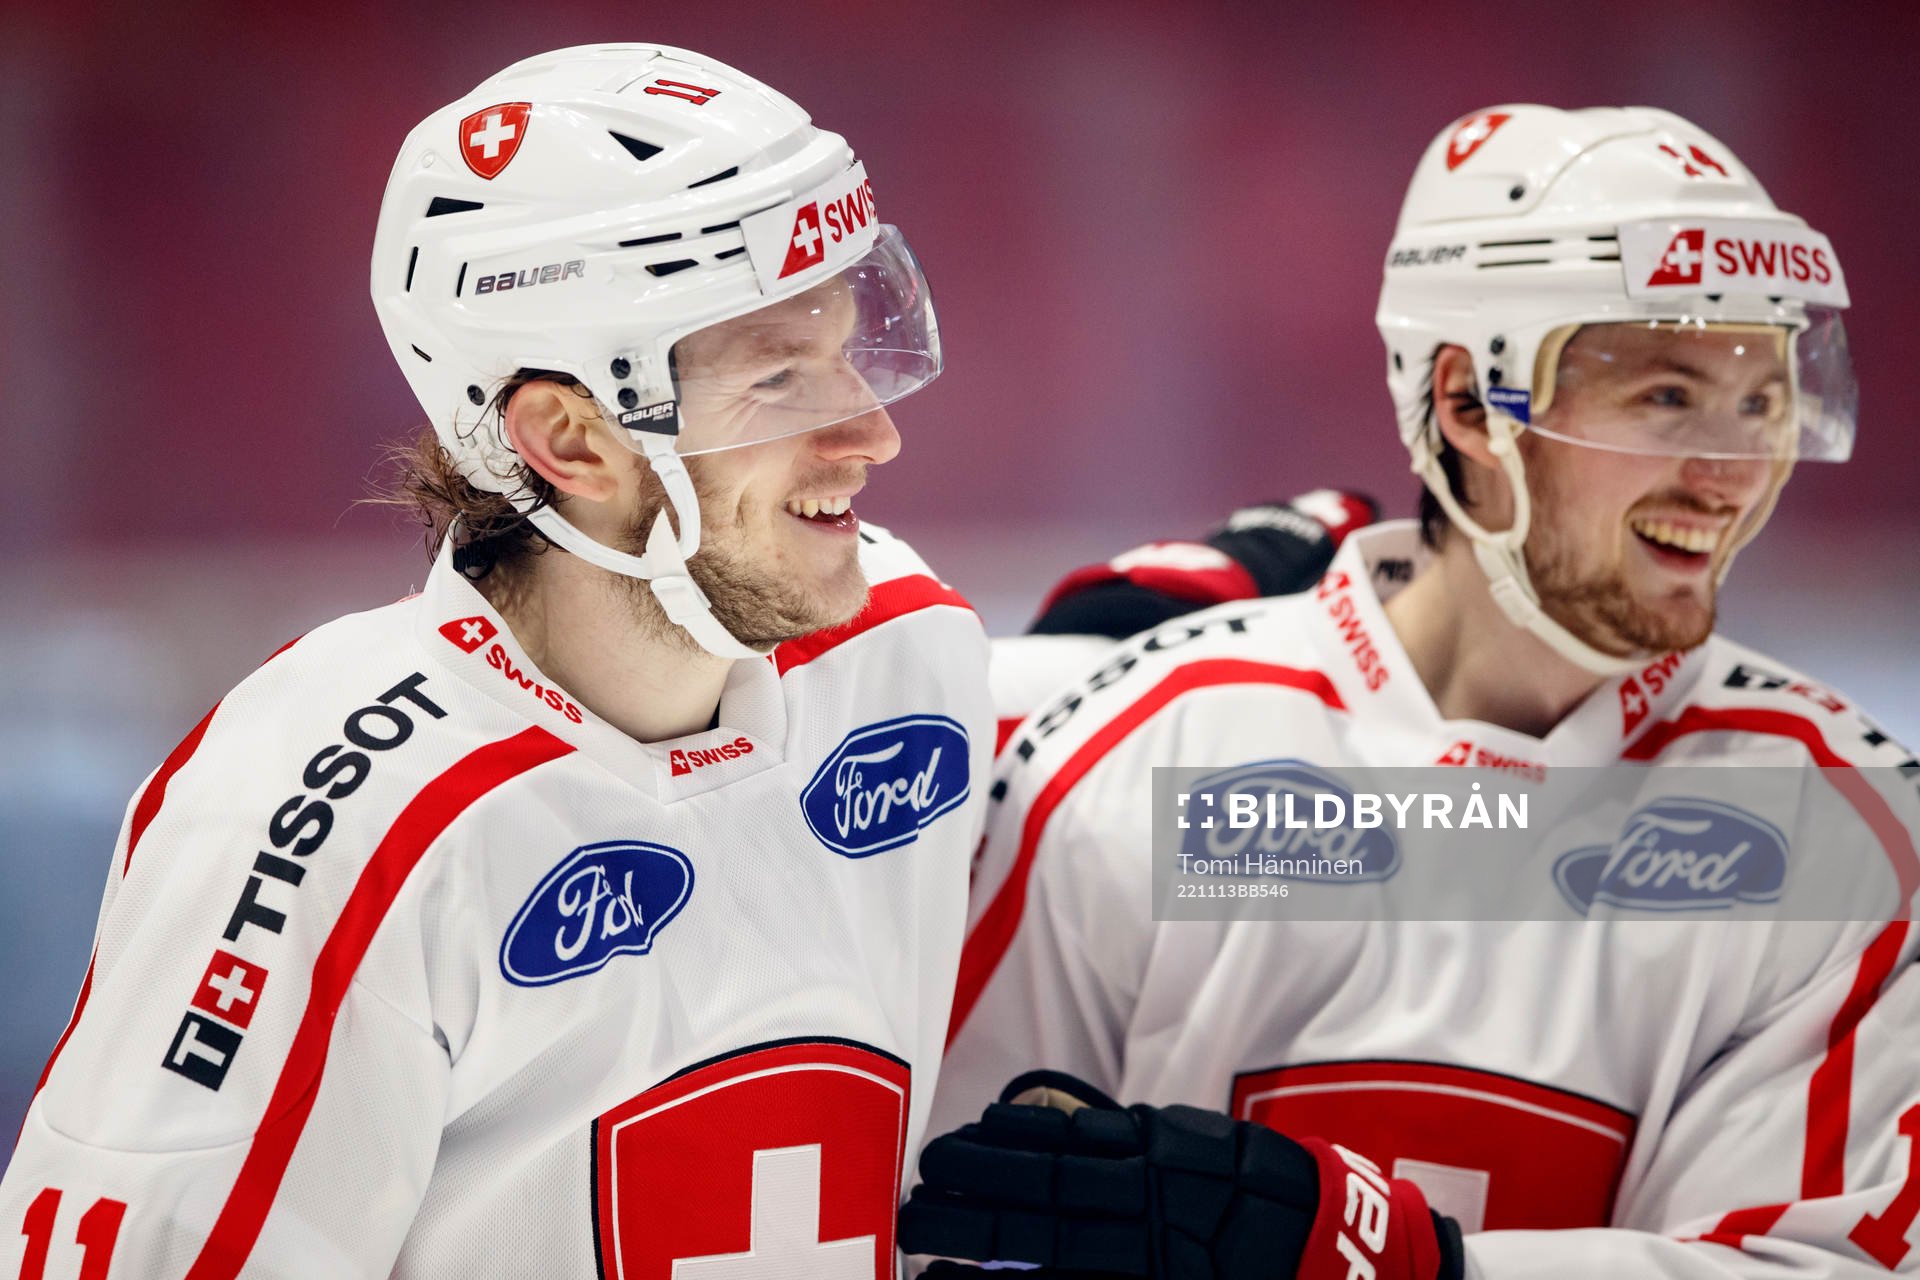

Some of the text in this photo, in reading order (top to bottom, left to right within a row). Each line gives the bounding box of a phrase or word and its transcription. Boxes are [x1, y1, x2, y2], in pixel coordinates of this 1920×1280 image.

[643, 79, 722, 106] 11
[475, 259, 586, 296] BAUER
[1714, 238, 1832, 286] SWISS
[621, 402, 674, 425] BAUER
[485, 643, 584, 725] SWISS
[1329, 595, 1390, 693] SWISS
[688, 736, 754, 769] SWISS
[834, 741, 943, 840] Ford
[222, 671, 449, 942] TISSOT
[1599, 812, 1751, 893] Ford
[18, 1187, 128, 1280] 11
